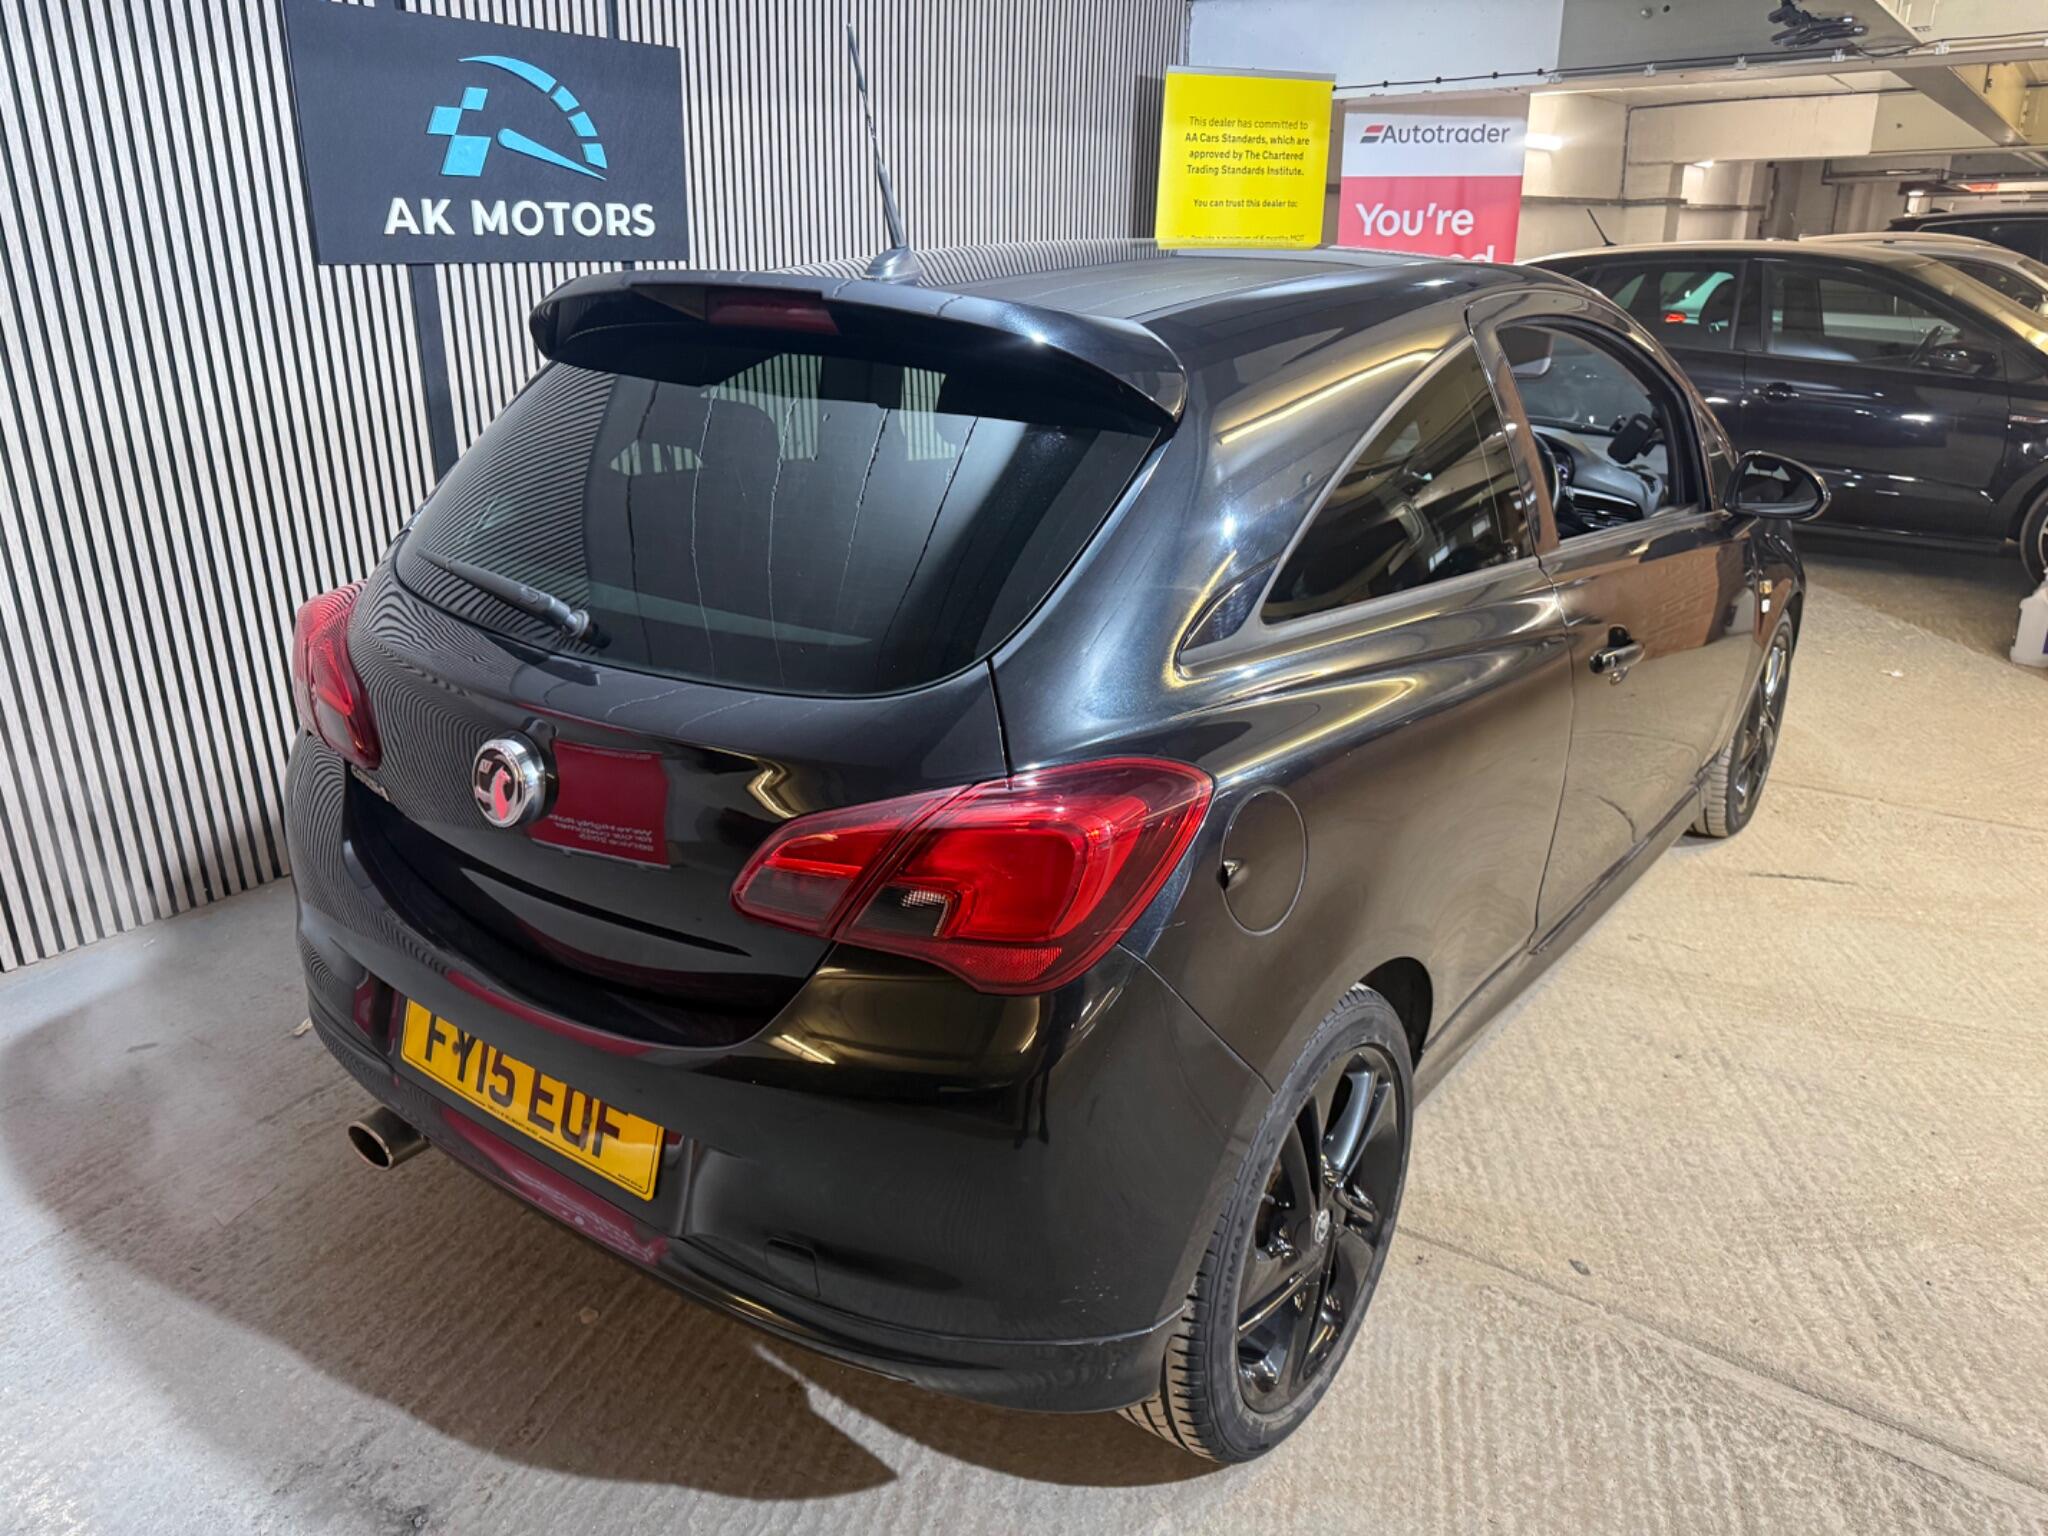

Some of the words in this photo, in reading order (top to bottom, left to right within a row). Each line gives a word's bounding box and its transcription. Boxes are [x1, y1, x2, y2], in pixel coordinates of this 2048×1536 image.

[1189, 116, 1206, 127] This
[1208, 117, 1235, 127] dealer
[1237, 119, 1252, 128] has
[1254, 120, 1299, 130] committed
[1300, 121, 1309, 130] to
[1185, 132, 1198, 142] AA
[1200, 133, 1219, 143] Cars
[1221, 133, 1268, 145] Standards,
[1270, 135, 1295, 145] which
[1297, 137, 1310, 146] are
[1382, 123, 1511, 144] Autotrader
[1189, 149, 1232, 160] approved
[1233, 150, 1243, 161] by
[1245, 150, 1260, 160] The
[1262, 150, 1304, 160] Chartered
[1186, 164, 1219, 176] Trading
[1221, 165, 1265, 175] Standards
[1267, 166, 1304, 176] Institute.
[1194, 199, 1208, 208] You
[1209, 200, 1224, 208] can
[1225, 199, 1244, 208] trust
[1245, 199, 1260, 208] this
[1262, 199, 1286, 208] dealer
[383, 196, 456, 236] AK
[471, 199, 656, 238] MOTORS
[425, 1013, 516, 1109] FY15
